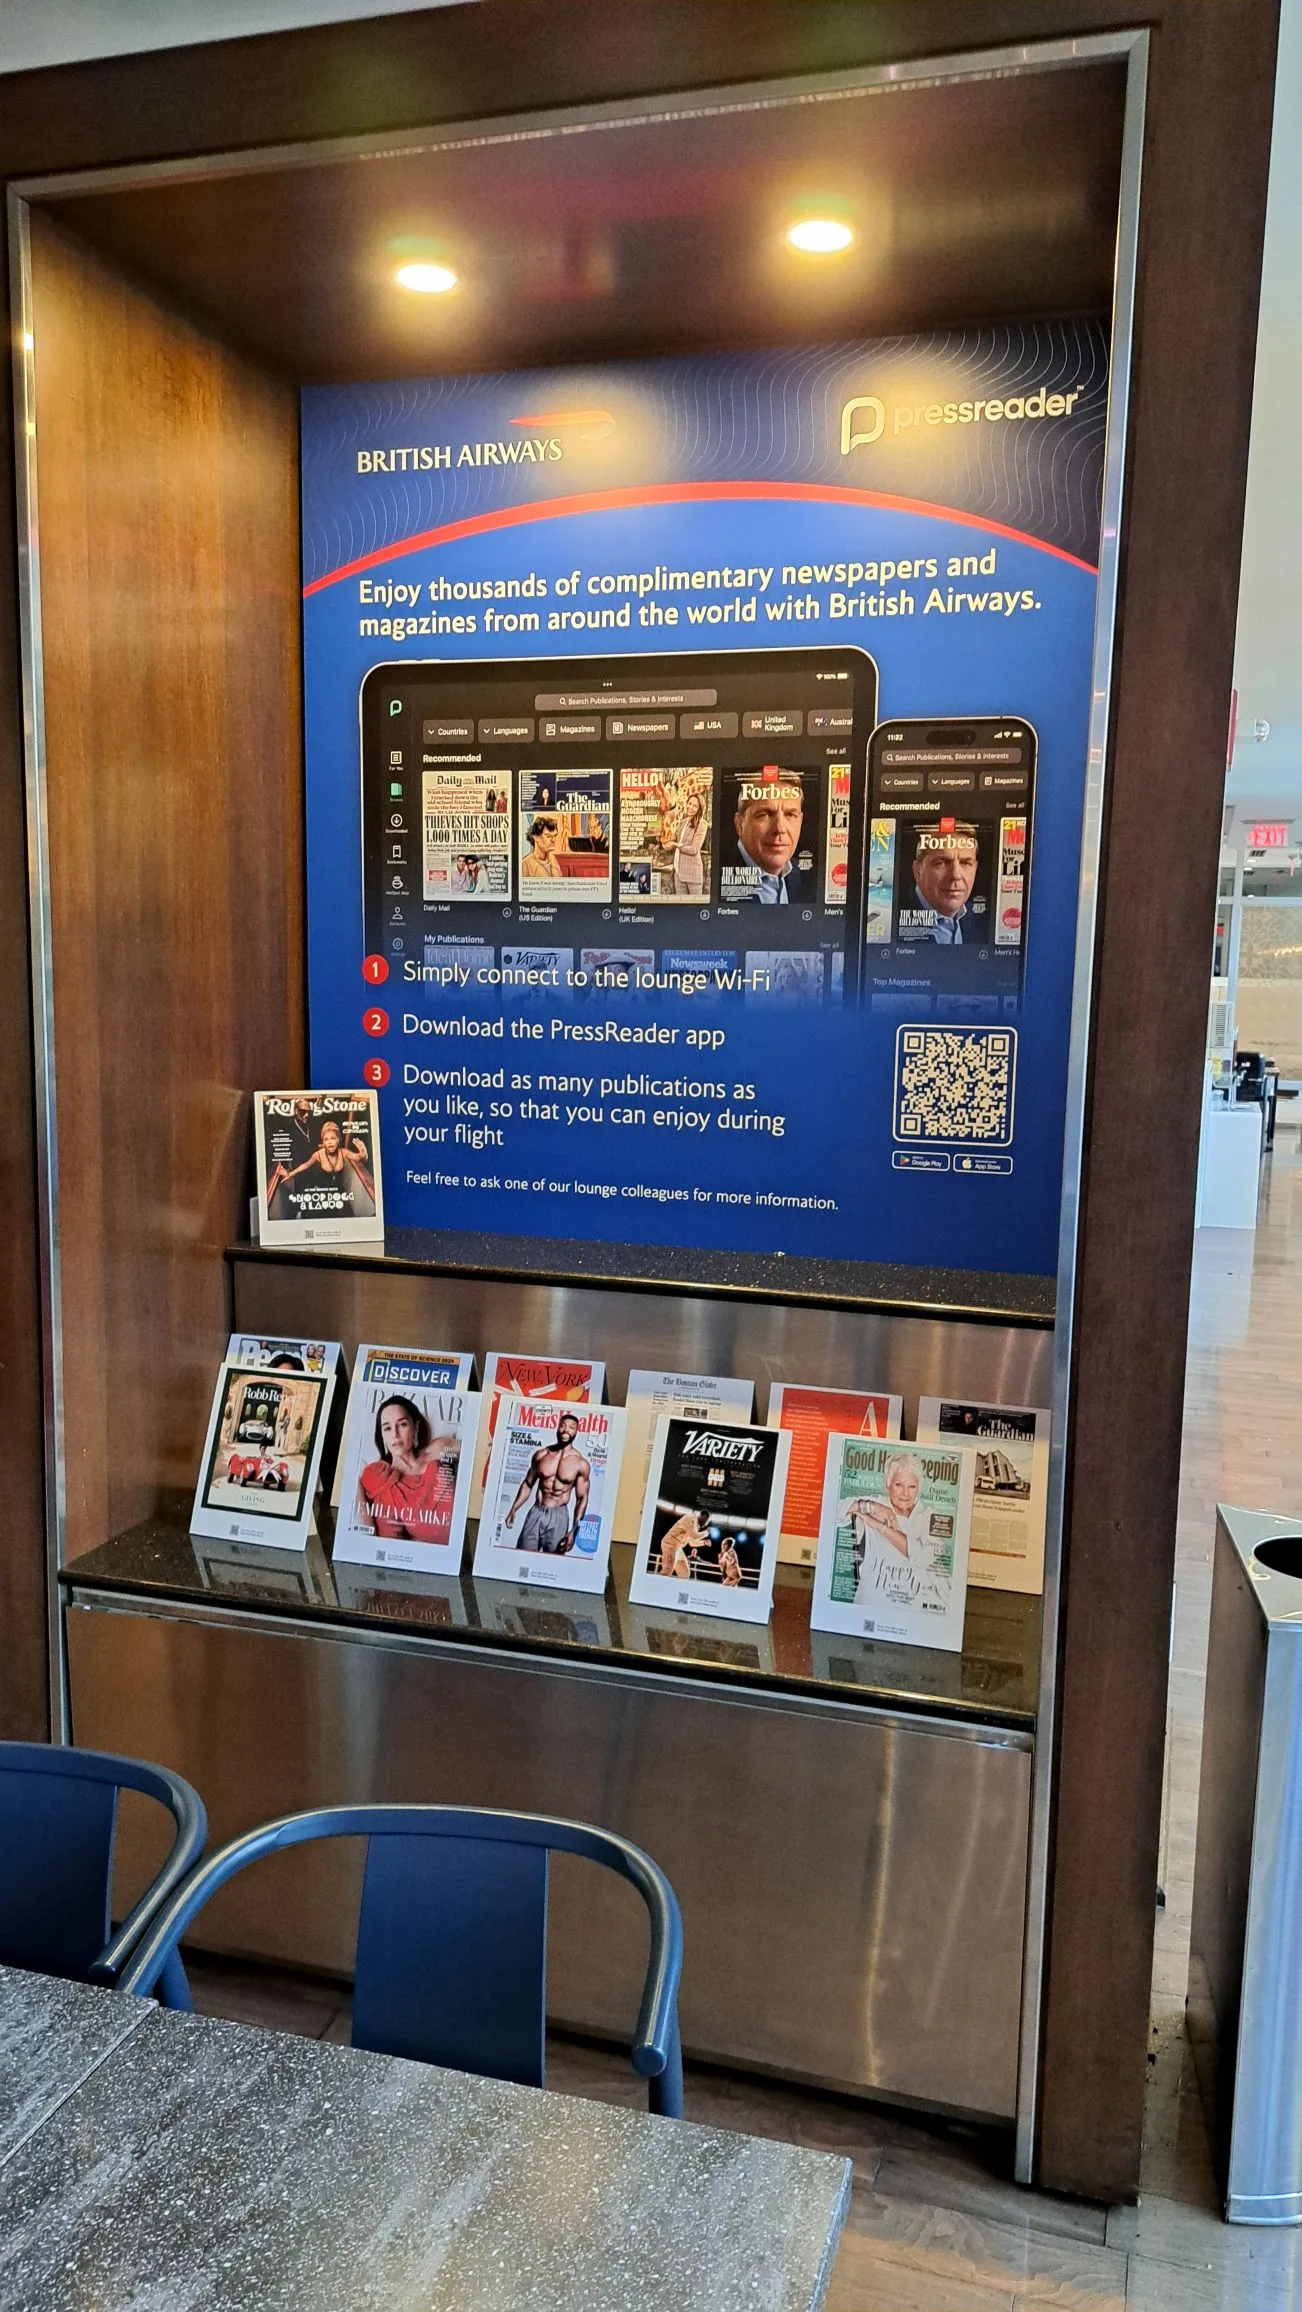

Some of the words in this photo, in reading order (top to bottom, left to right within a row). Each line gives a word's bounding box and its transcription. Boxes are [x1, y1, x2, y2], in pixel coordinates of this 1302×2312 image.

[357, 446, 452, 474] BRITISH
[457, 438, 563, 468] AIRWAYS
[359, 580, 421, 608] Enjoy
[429, 573, 547, 601] thousands
[555, 571, 581, 596] of
[587, 565, 774, 598] complimentary
[782, 556, 938, 588] newspapers
[947, 548, 996, 576] and
[359, 610, 478, 640] magazines
[484, 607, 540, 634] from
[548, 602, 631, 631] around
[638, 601, 679, 626] the
[687, 598, 757, 625] world
[765, 594, 821, 621] with
[828, 588, 915, 619] British
[923, 587, 1042, 617] Airways.
[568, 697, 589, 706] Search
[590, 696, 627, 706] Publications,
[628, 695, 650, 704] Stories
[657, 694, 684, 703] Interests
[707, 721, 722, 730] USA
[764, 715, 787, 724] United
[437, 727, 468, 736] Countries
[493, 726, 529, 736] Languages
[559, 724, 596, 735] Magazines
[627, 723, 669, 733] Newspapers
[764, 723, 794, 733] Kingdom
[422, 753, 482, 764] Recommended
[437, 775, 462, 787] Daily
[474, 775, 497, 785] Mail
[622, 772, 663, 787] HELLO!
[566, 792, 588, 803] The
[741, 783, 801, 801] Forbes
[556, 800, 610, 812] Guardian
[879, 802, 940, 811] Recommended
[425, 815, 462, 829] THIEVES
[464, 815, 479, 828] HIT
[480, 815, 510, 829] SHOPS
[452, 830, 480, 843] TIMES
[483, 830, 488, 843] A
[490, 830, 508, 843] DAY
[919, 834, 976, 850] Forbes
[1254, 824, 1287, 848] EXIT
[423, 905, 438, 913] Daily
[438, 904, 450, 912] Mail
[718, 908, 739, 916] Forbes
[531, 914, 553, 922] Edition)
[631, 915, 655, 924] Edition)
[424, 935, 437, 945] My
[437, 935, 485, 944] Publications
[670, 958, 729, 970] Newsweek
[372, 961, 379, 978] 1
[403, 961, 471, 987] Simply
[477, 967, 559, 986] connect
[566, 970, 588, 987] to
[595, 967, 629, 988] the
[636, 967, 707, 994] lounge
[714, 969, 771, 991] Wi-Fi
[873, 978, 888, 987] Top
[888, 978, 931, 987] Magazines
[371, 1014, 381, 1030] 2
[403, 1014, 504, 1038] Download
[511, 1018, 544, 1039] the
[551, 1019, 680, 1044] PressReader
[686, 1029, 726, 1050] app
[372, 1065, 382, 1081] 3
[403, 1064, 504, 1089] Download
[511, 1074, 532, 1089] as
[538, 1075, 594, 1097] many
[600, 1074, 726, 1098] publications
[733, 1084, 756, 1100] as
[321, 1097, 367, 1114] Stone
[403, 1098, 440, 1116] you
[446, 1095, 484, 1119] like,
[490, 1102, 513, 1117] so
[519, 1098, 559, 1120] that
[566, 1106, 604, 1125] you
[610, 1108, 646, 1124] can
[653, 1106, 711, 1132] enjoy
[717, 1108, 786, 1137] during
[404, 1126, 449, 1145] your
[454, 1123, 504, 1149] flight
[406, 1170, 432, 1184] Feel
[435, 1172, 460, 1186] free
[463, 1176, 477, 1187] to
[480, 1175, 501, 1189] ask
[504, 1180, 529, 1190] one
[532, 1178, 546, 1191] of
[549, 1183, 571, 1193] our
[574, 1180, 617, 1198] lounge
[621, 1184, 689, 1202] colleagues
[693, 1188, 713, 1201] for
[716, 1192, 751, 1204] more
[755, 1192, 839, 1211] information.
[663, 1377, 674, 1385] The
[243, 1387, 269, 1401] Robb
[988, 1418, 1012, 1431] The
[510, 1431, 526, 1440] SIZE
[977, 1425, 1034, 1442] Guardian
[510, 1438, 542, 1447] STAMINA
[682, 1430, 765, 1462] VARIETY
[846, 1446, 876, 1471] Good
[844, 1470, 857, 1479] 52
[929, 1487, 949, 1496] Dame
[935, 1494, 957, 1503] Dench
[357, 1501, 399, 1521] EMILIA
[401, 1505, 451, 1526] CLARKE
[871, 1557, 914, 1582] Happy
